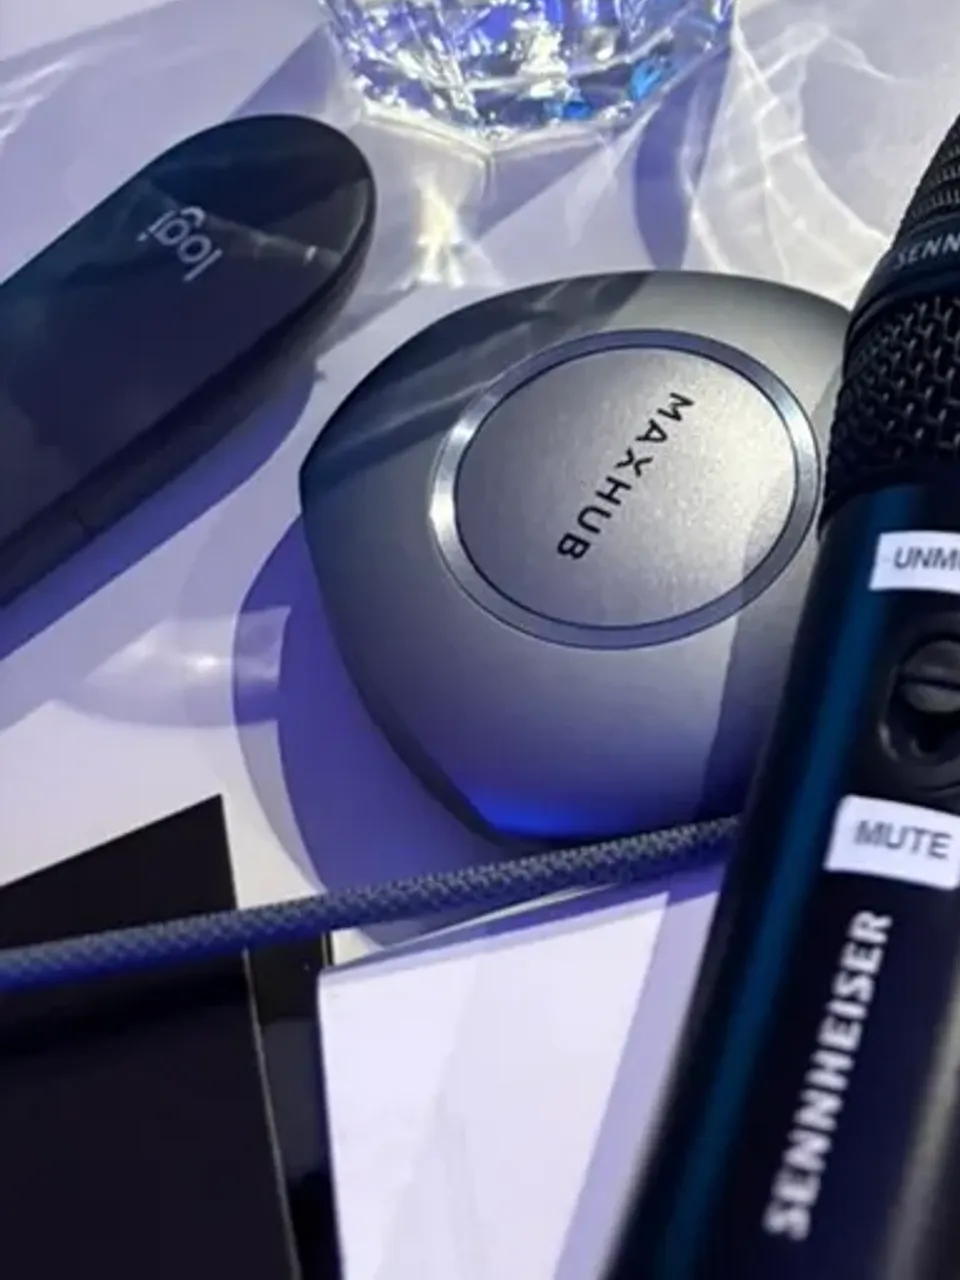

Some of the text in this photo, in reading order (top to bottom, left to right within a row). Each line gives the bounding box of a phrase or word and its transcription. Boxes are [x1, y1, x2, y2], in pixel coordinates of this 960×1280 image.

[136, 205, 223, 282] logi
[557, 391, 695, 561] MAXHUB
[853, 819, 955, 861] MUTE
[762, 910, 893, 1242] SENNHEISER
